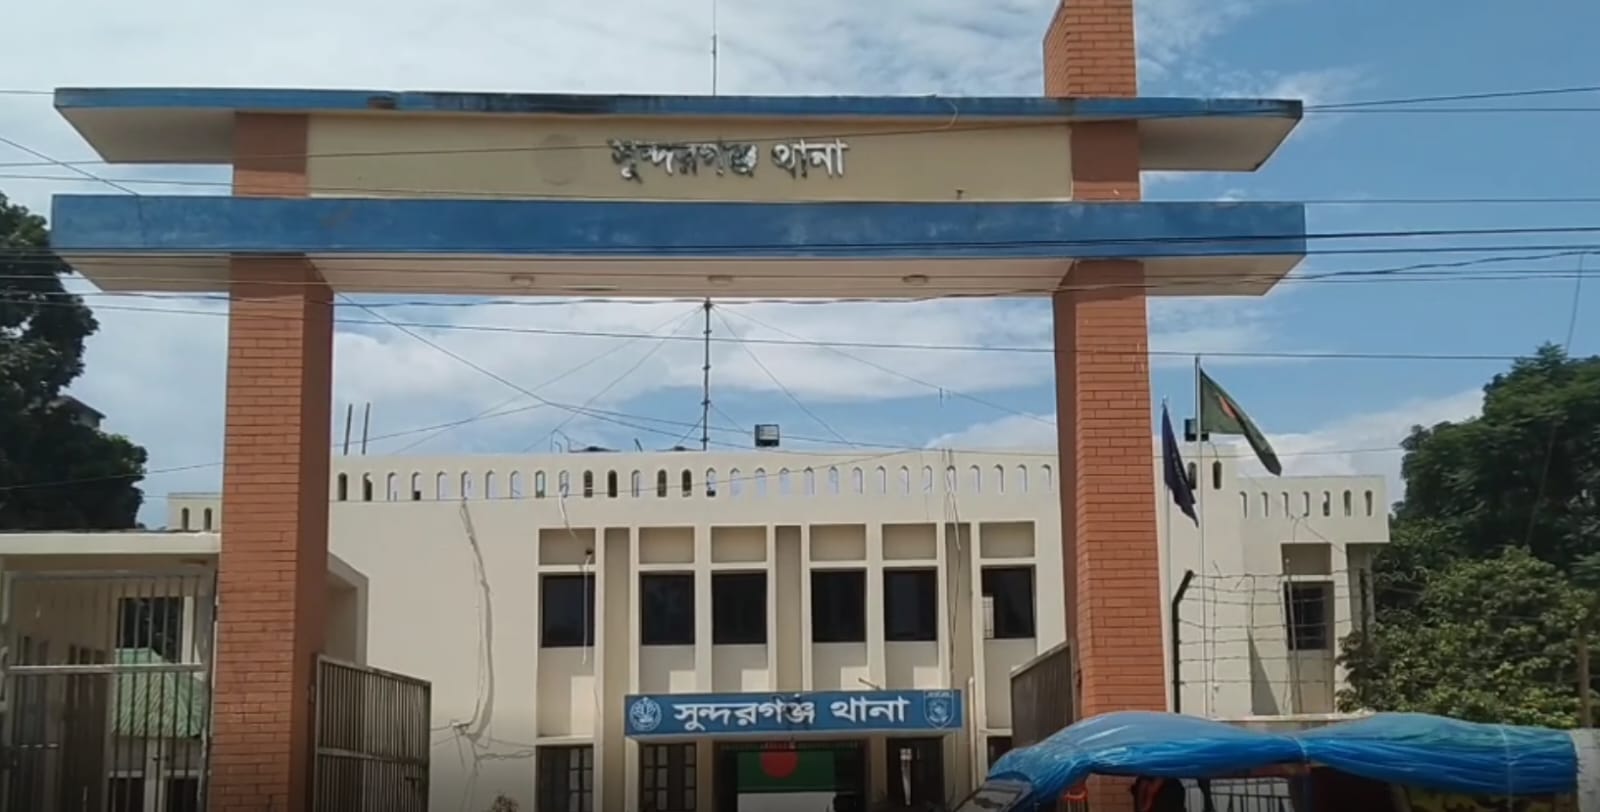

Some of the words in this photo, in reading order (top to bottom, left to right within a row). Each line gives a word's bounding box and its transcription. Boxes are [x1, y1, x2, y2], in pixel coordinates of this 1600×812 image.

[771, 138, 849, 178] থানা
[672, 701, 815, 732] সুন্দরগঞ্জ
[830, 696, 910, 723] থানা
